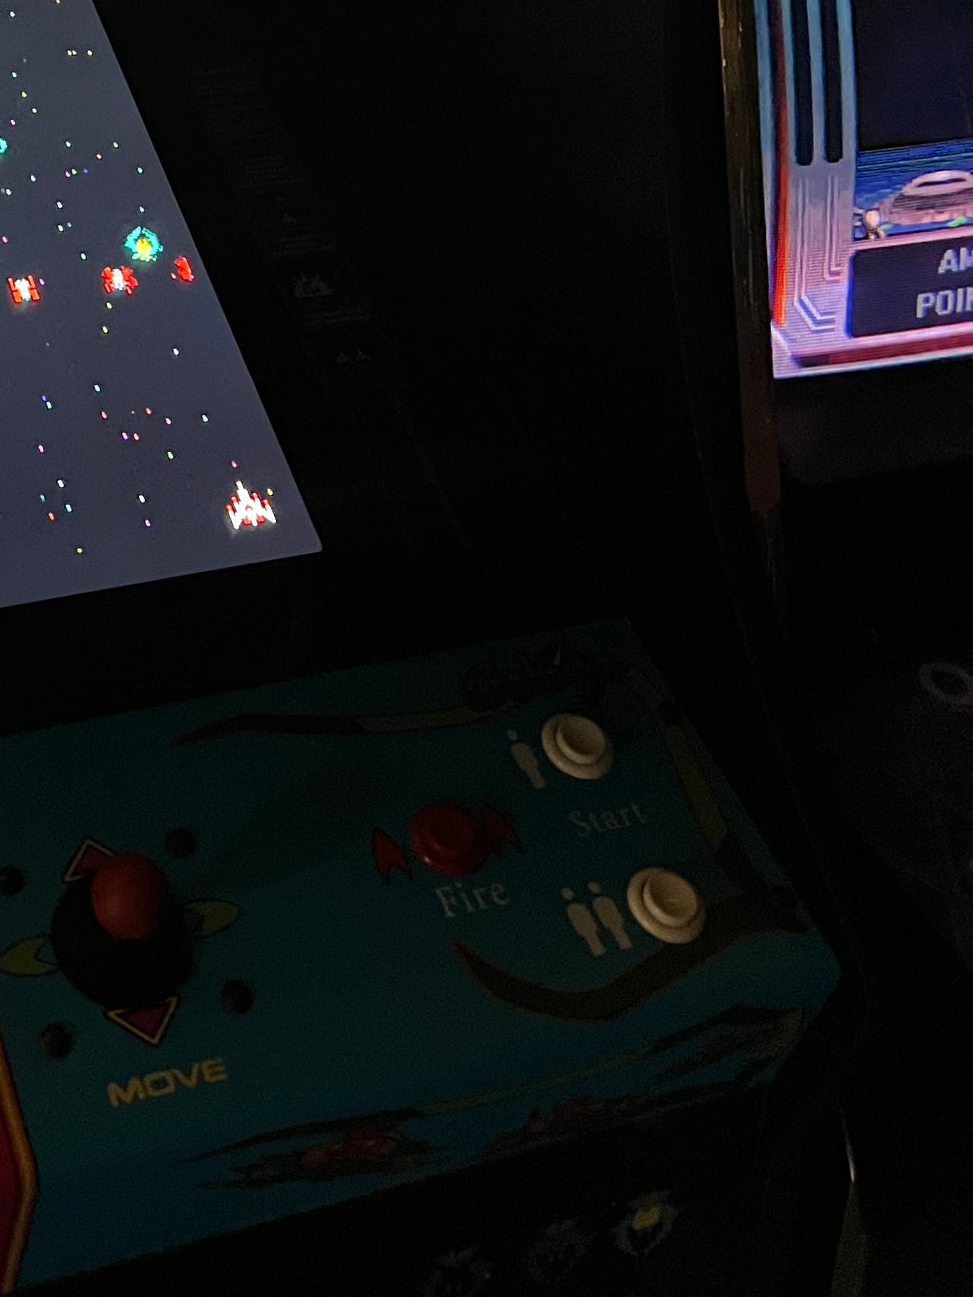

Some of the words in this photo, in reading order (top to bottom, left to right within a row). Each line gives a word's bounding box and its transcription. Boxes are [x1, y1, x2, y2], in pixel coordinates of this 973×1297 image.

[567, 802, 648, 838] Start
[434, 879, 511, 919] Fire
[106, 1056, 229, 1109] MOVE
